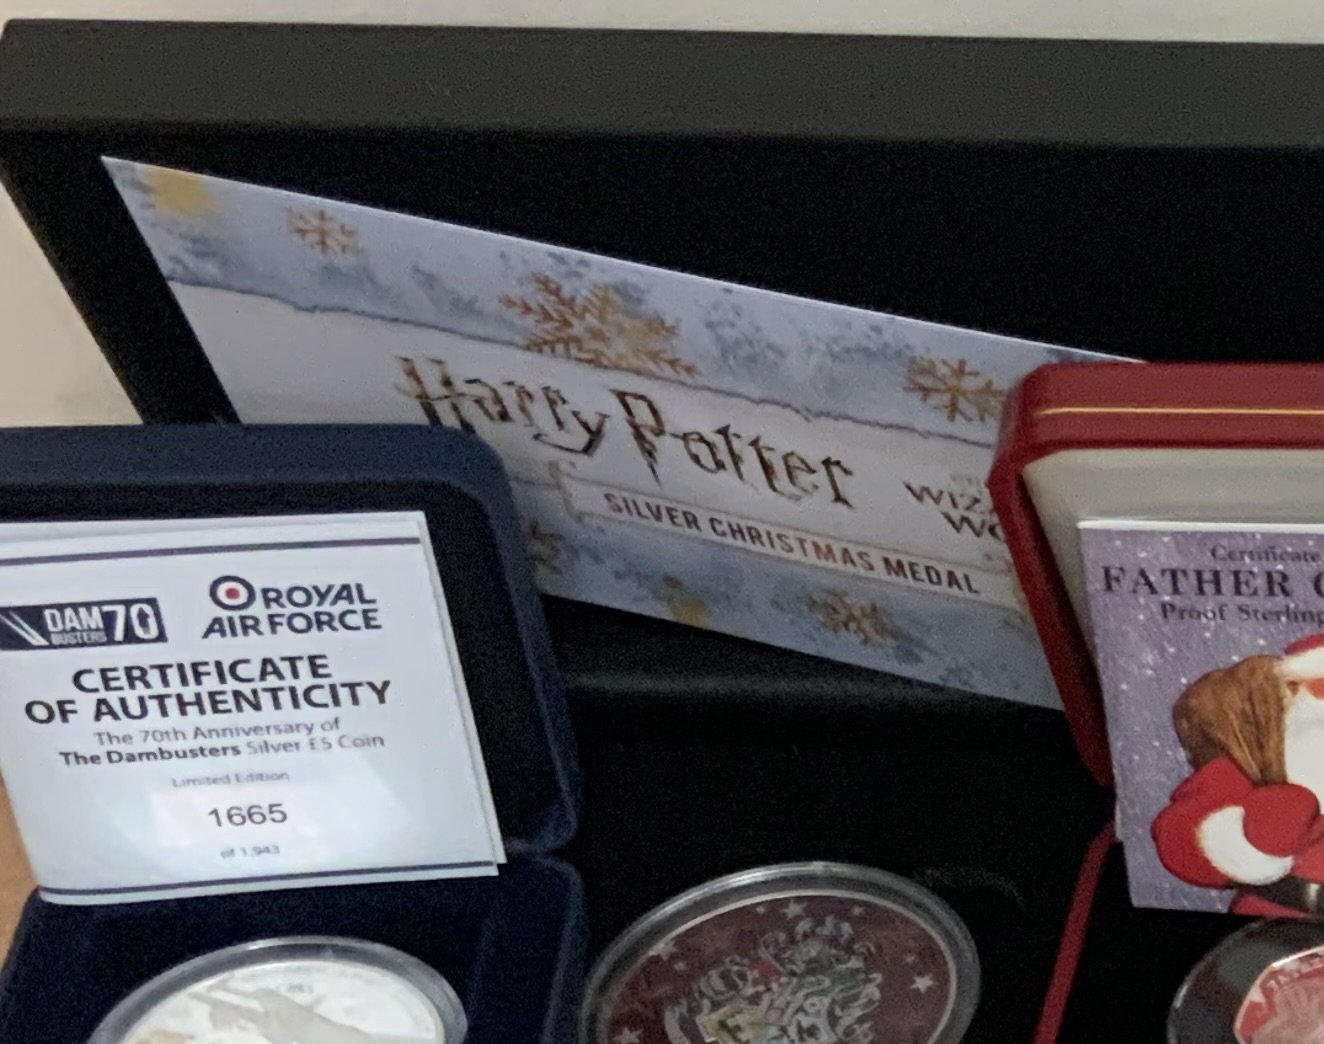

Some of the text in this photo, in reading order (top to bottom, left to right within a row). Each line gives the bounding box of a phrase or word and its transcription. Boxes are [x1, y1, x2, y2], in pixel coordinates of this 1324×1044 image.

[395, 356, 857, 509] Harry Potter
[604, 492, 981, 595] SILVER CHRISTMAS MEDAL
[1210, 543, 1322, 566] Certificate
[261, 582, 378, 610] ROYAL
[1100, 565, 1292, 599] FATHER
[44, 602, 158, 642] DAM 70
[200, 608, 383, 640] AIR FORCE
[1160, 601, 1227, 624] Proof
[50, 630, 108, 646] BUSTERS
[71, 654, 333, 694] CERTIFICATE
[24, 679, 392, 725] OF AUTHENTICITY
[94, 717, 343, 747] The 70th Anniversary of
[60, 734, 386, 767] The Dambusters Silver £5 Coin
[171, 770, 290, 789] Limited Edition
[207, 802, 289, 829] 1665
